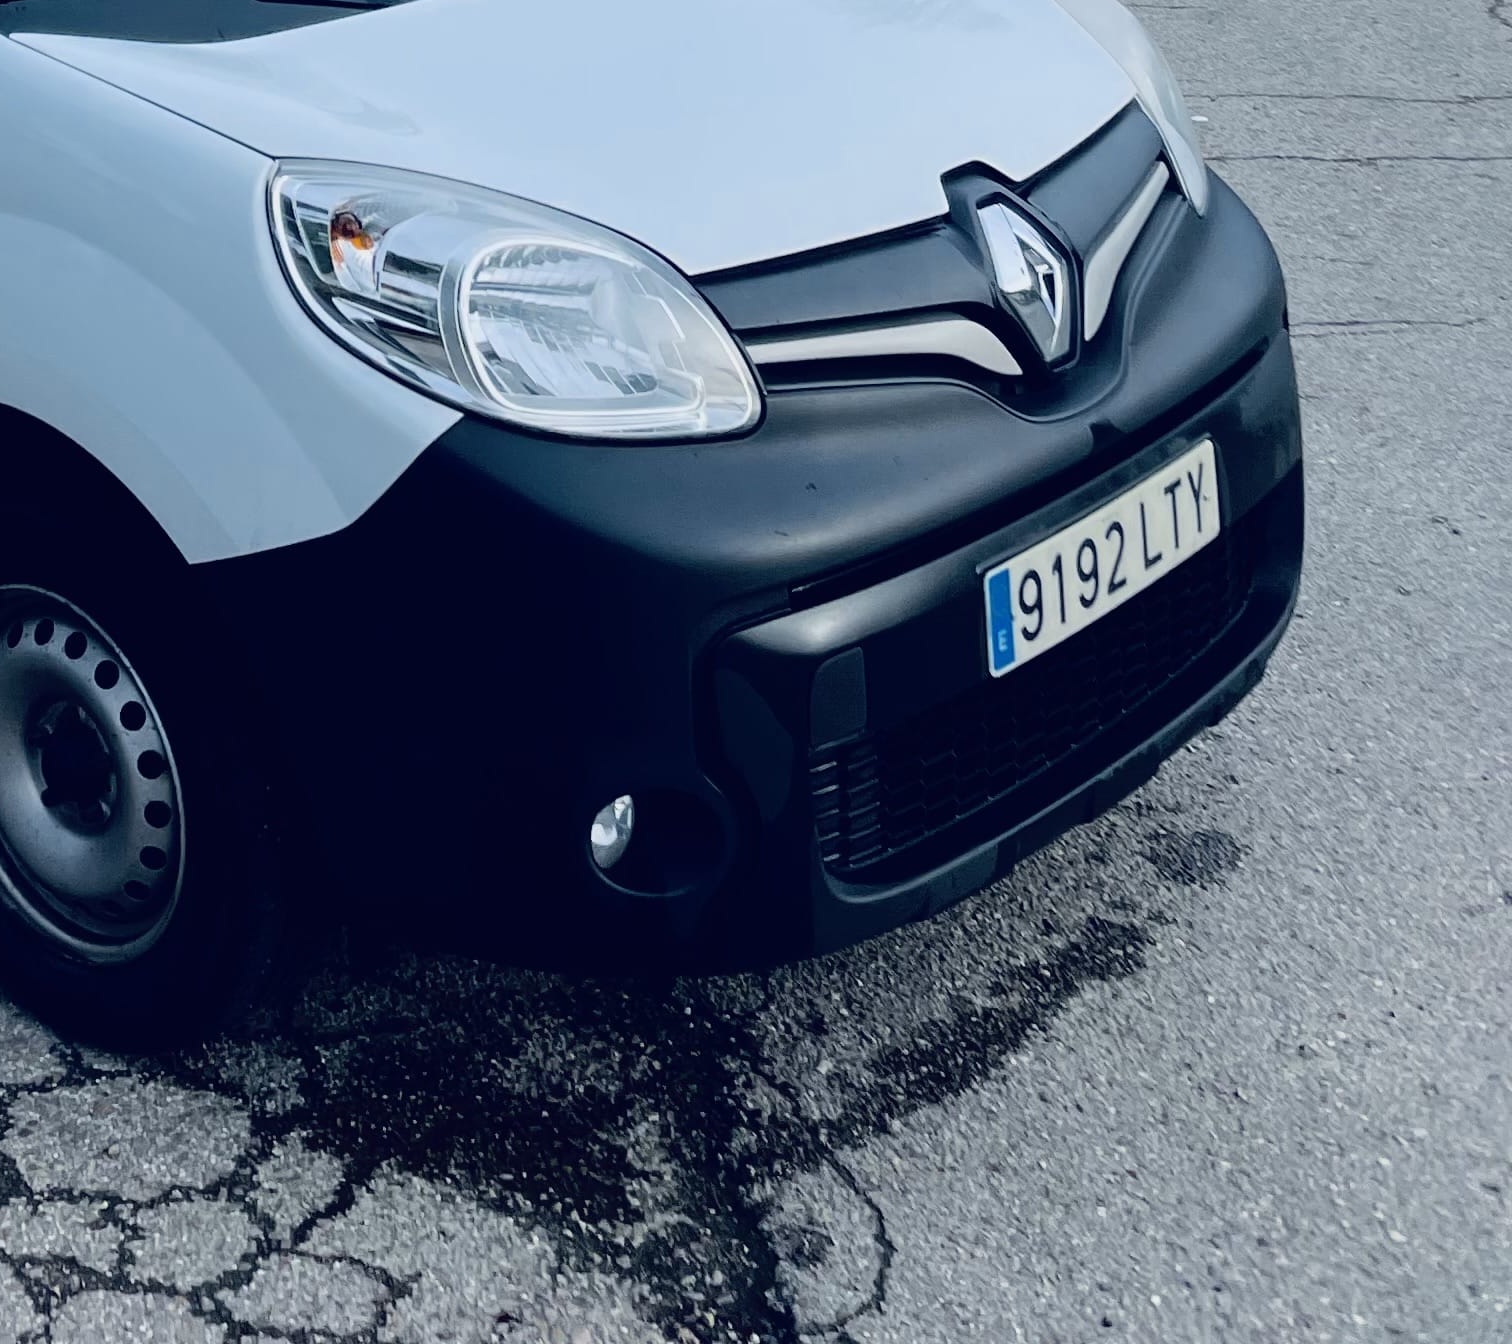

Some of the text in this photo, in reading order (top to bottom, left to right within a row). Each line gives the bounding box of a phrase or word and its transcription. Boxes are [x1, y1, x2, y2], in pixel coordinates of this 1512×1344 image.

[1018, 461, 1205, 642] 9192 LTY
[996, 630, 1008, 653] E
